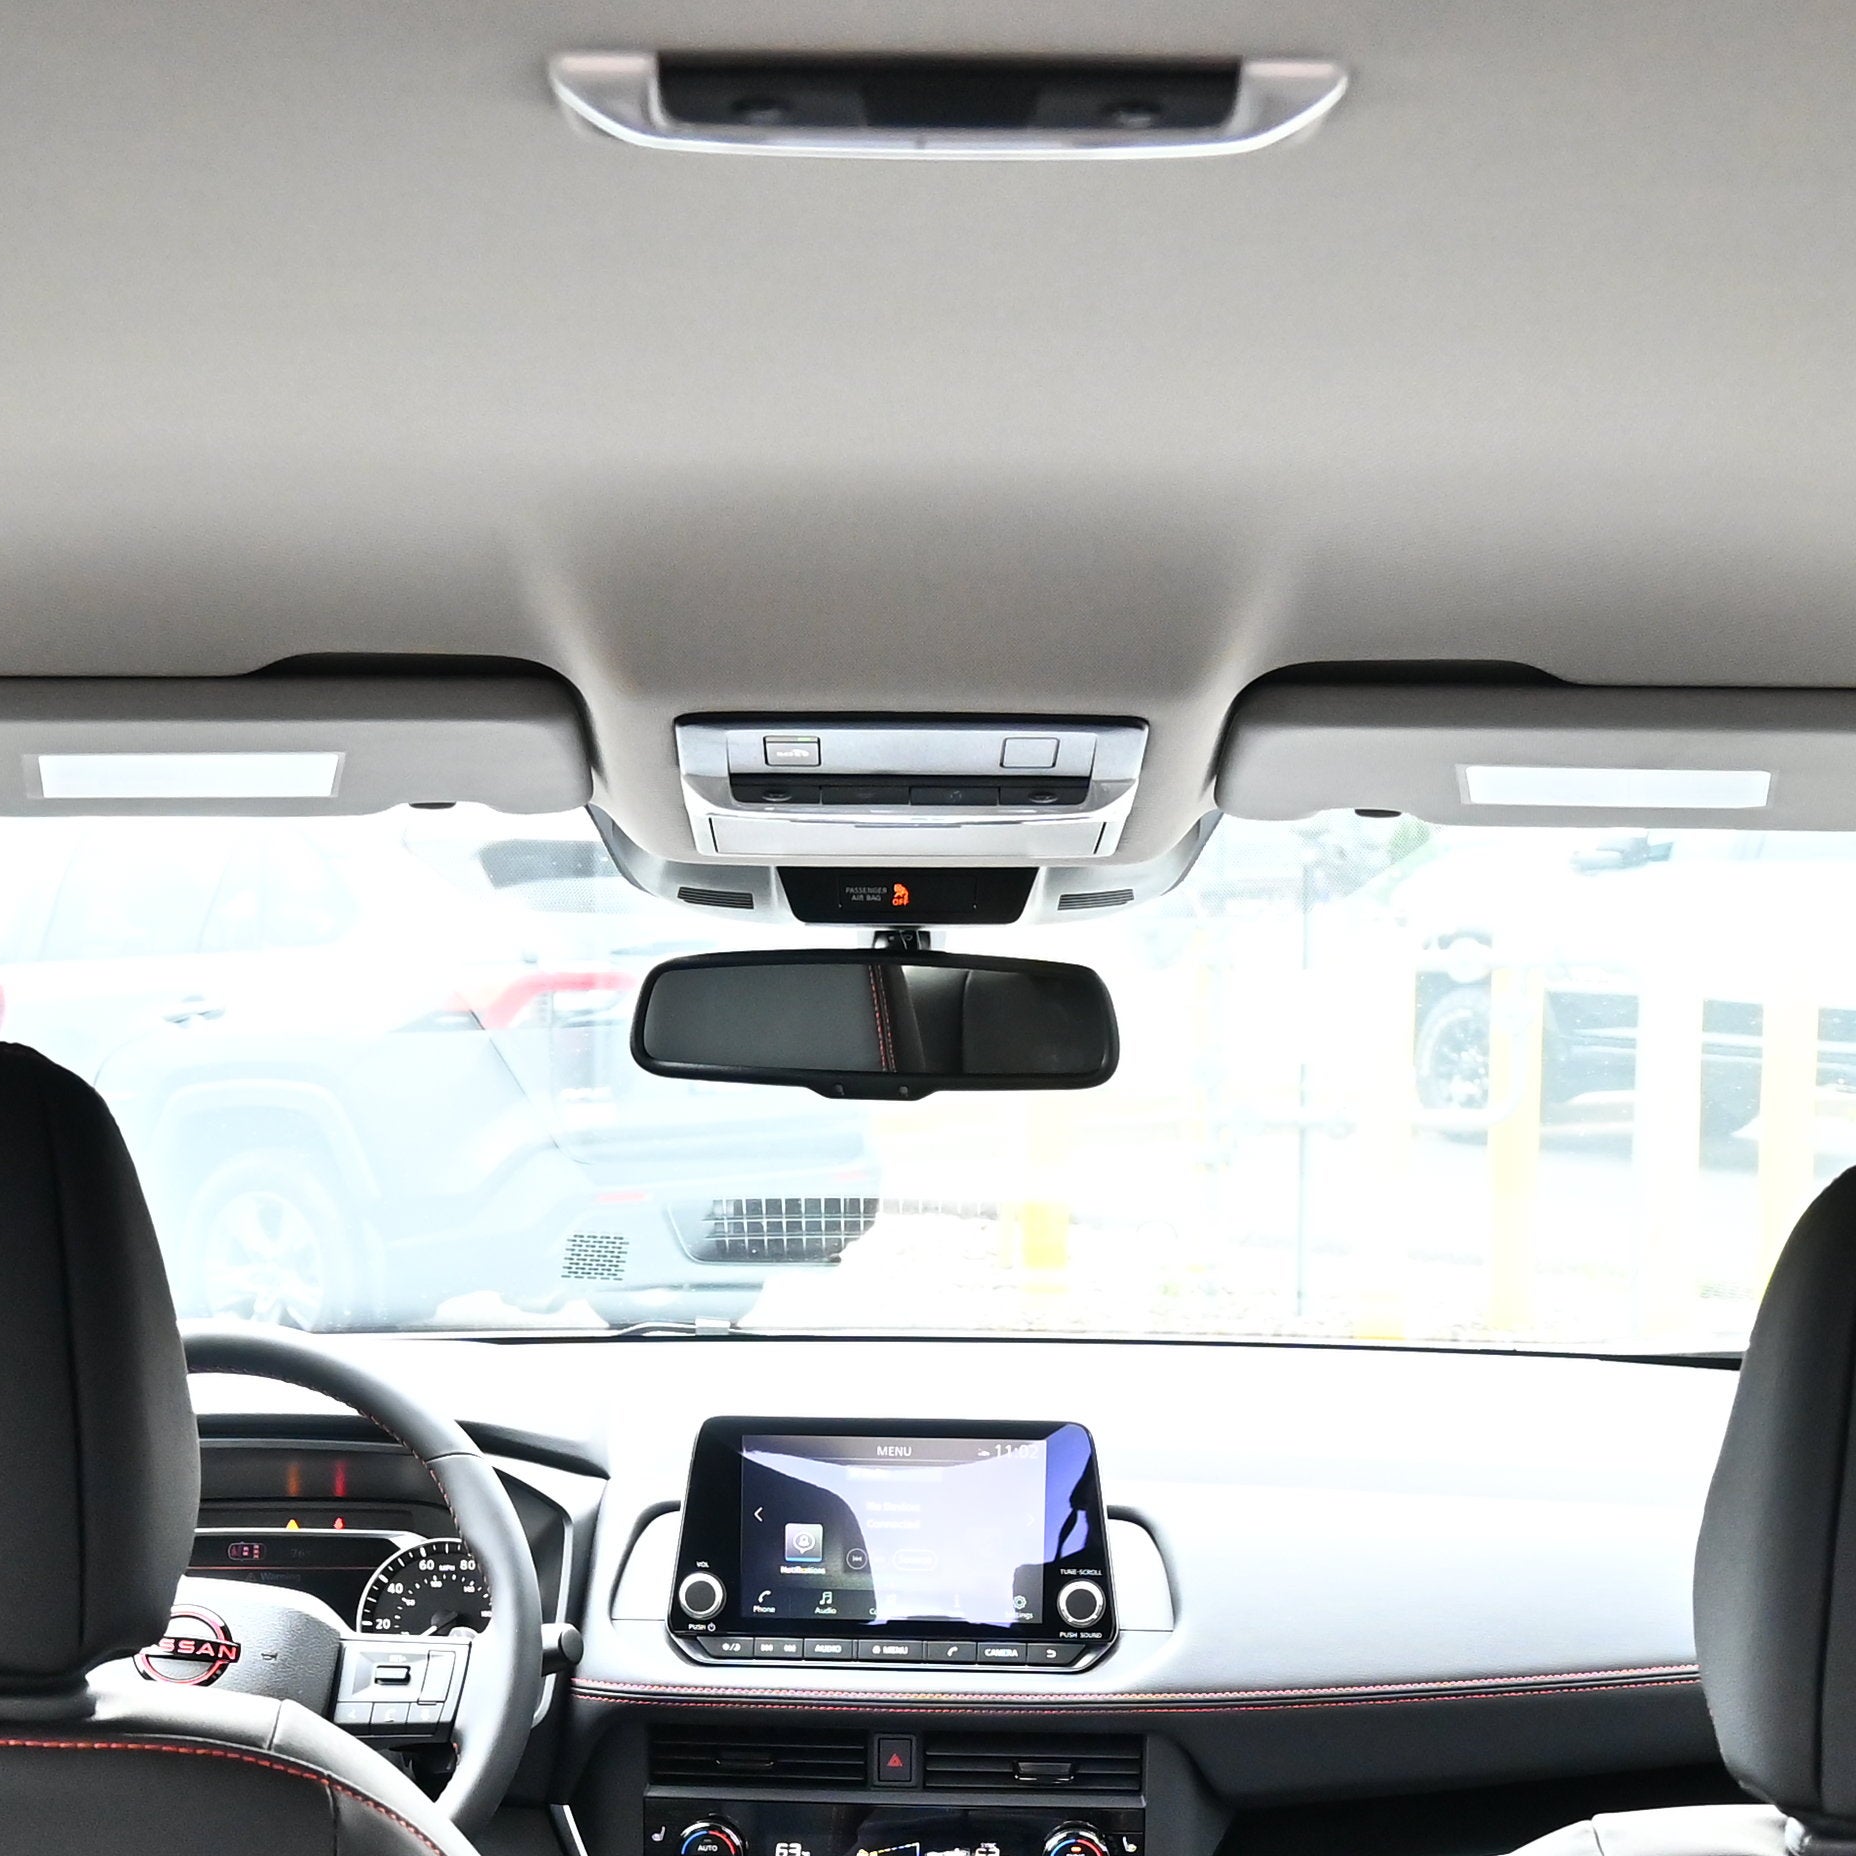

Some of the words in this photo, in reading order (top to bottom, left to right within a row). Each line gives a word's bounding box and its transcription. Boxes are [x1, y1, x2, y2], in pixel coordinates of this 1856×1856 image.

[846, 886, 887, 894] PASSENGER
[892, 898, 908, 906] OFF
[876, 1446, 912, 1457] MENU
[994, 1443, 1040, 1459] 11:02
[419, 1559, 435, 1571] 60
[459, 1559, 476, 1571] 80
[780, 1566, 826, 1575] Notifications
[387, 1582, 404, 1594] 40
[753, 1605, 776, 1613] Phone
[375, 1618, 391, 1630] 20
[688, 1623, 706, 1631] PUSH
[159, 1637, 237, 1659] SSAN
[814, 1644, 842, 1653] AUDIO
[882, 1645, 909, 1654] MENU
[984, 1648, 1019, 1657] CAMERA
[697, 1844, 718, 1852] AUTO
